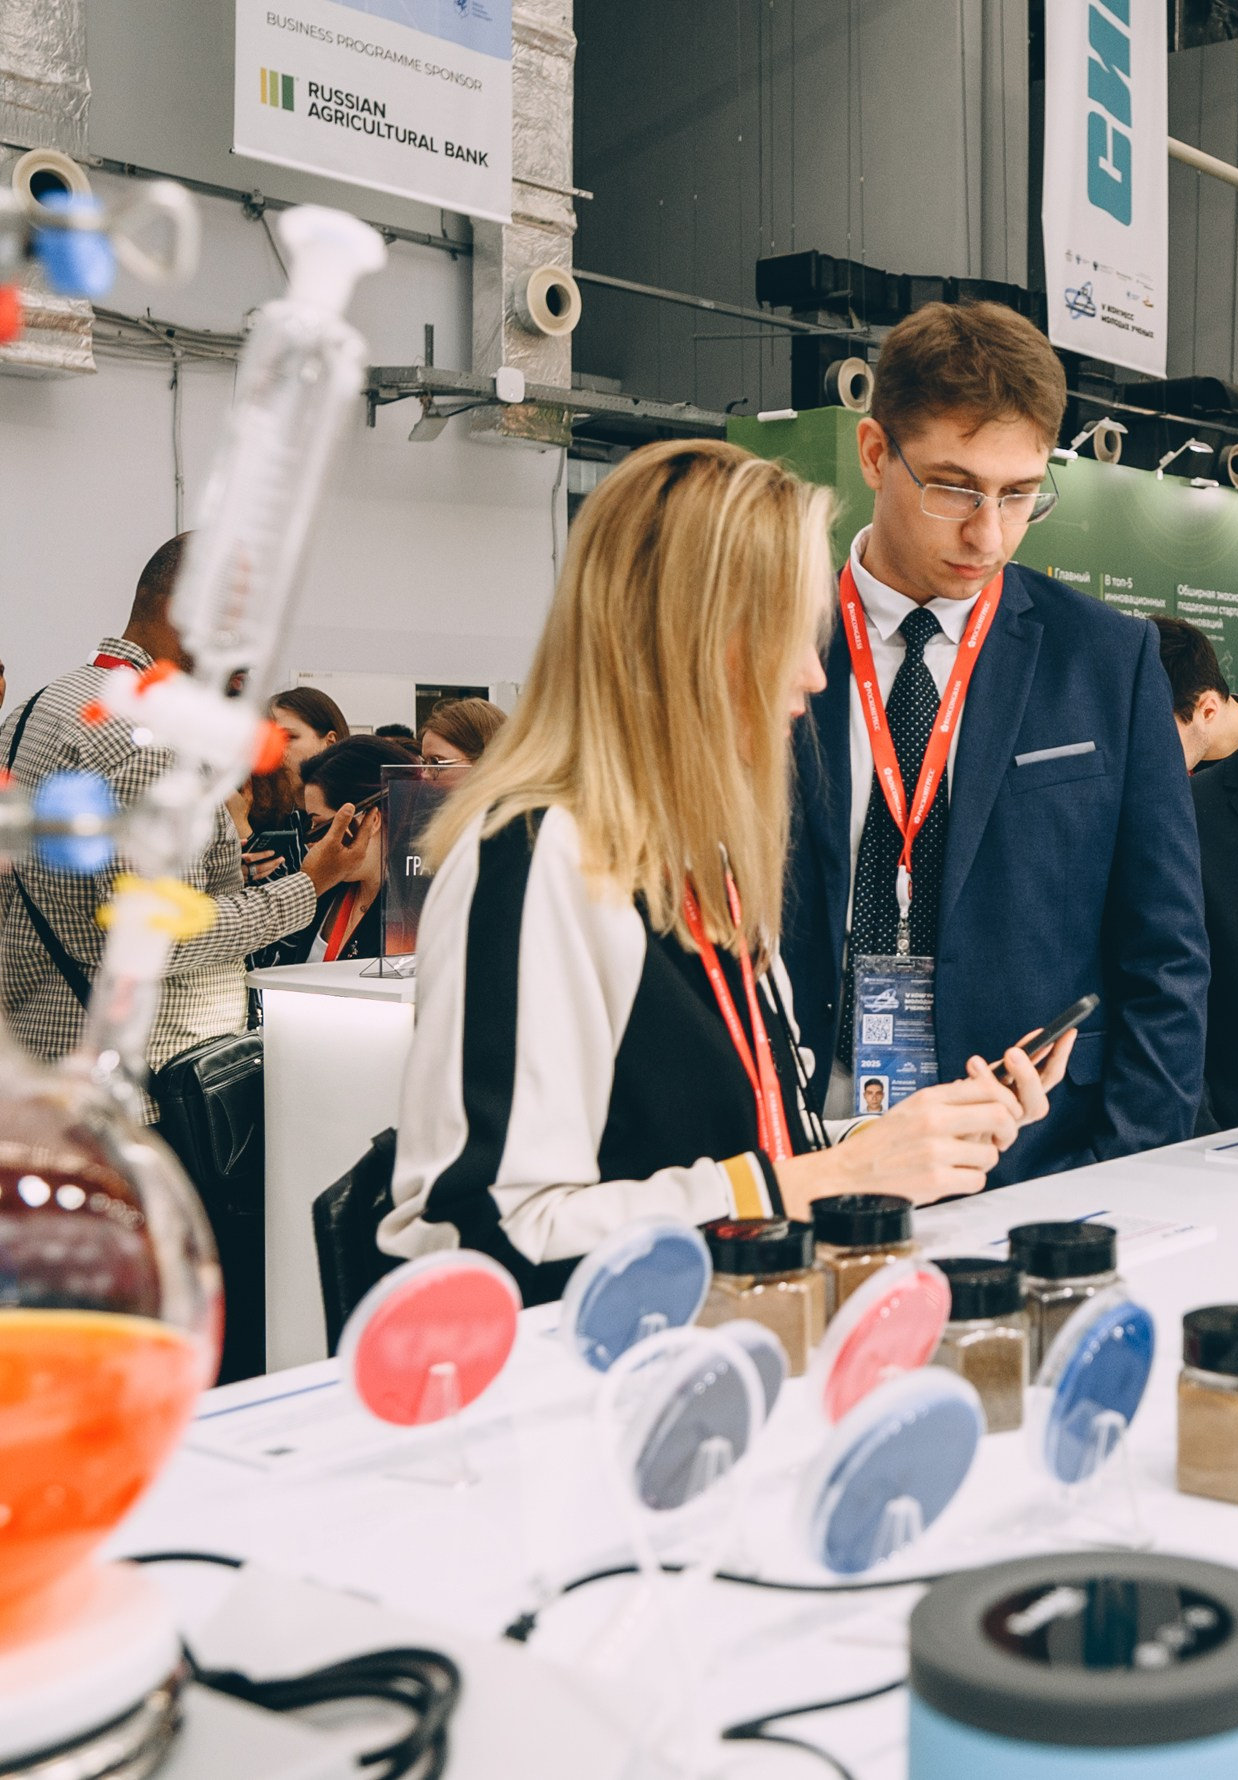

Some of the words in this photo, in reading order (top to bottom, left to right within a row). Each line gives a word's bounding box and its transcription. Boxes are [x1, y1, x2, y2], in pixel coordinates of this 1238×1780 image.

[266, 11, 334, 44] BUSINESS
[337, 34, 423, 72] PROGRAMME
[425, 62, 483, 92] SPONSOR
[308, 81, 386, 118] RUSSIAN
[1087, 0, 1132, 227] СИ
[308, 105, 439, 154] AGRICULTURAL
[444, 140, 489, 168] BANK
[1054, 567, 1091, 583] Главный
[1112, 577, 1134, 589] топ-5
